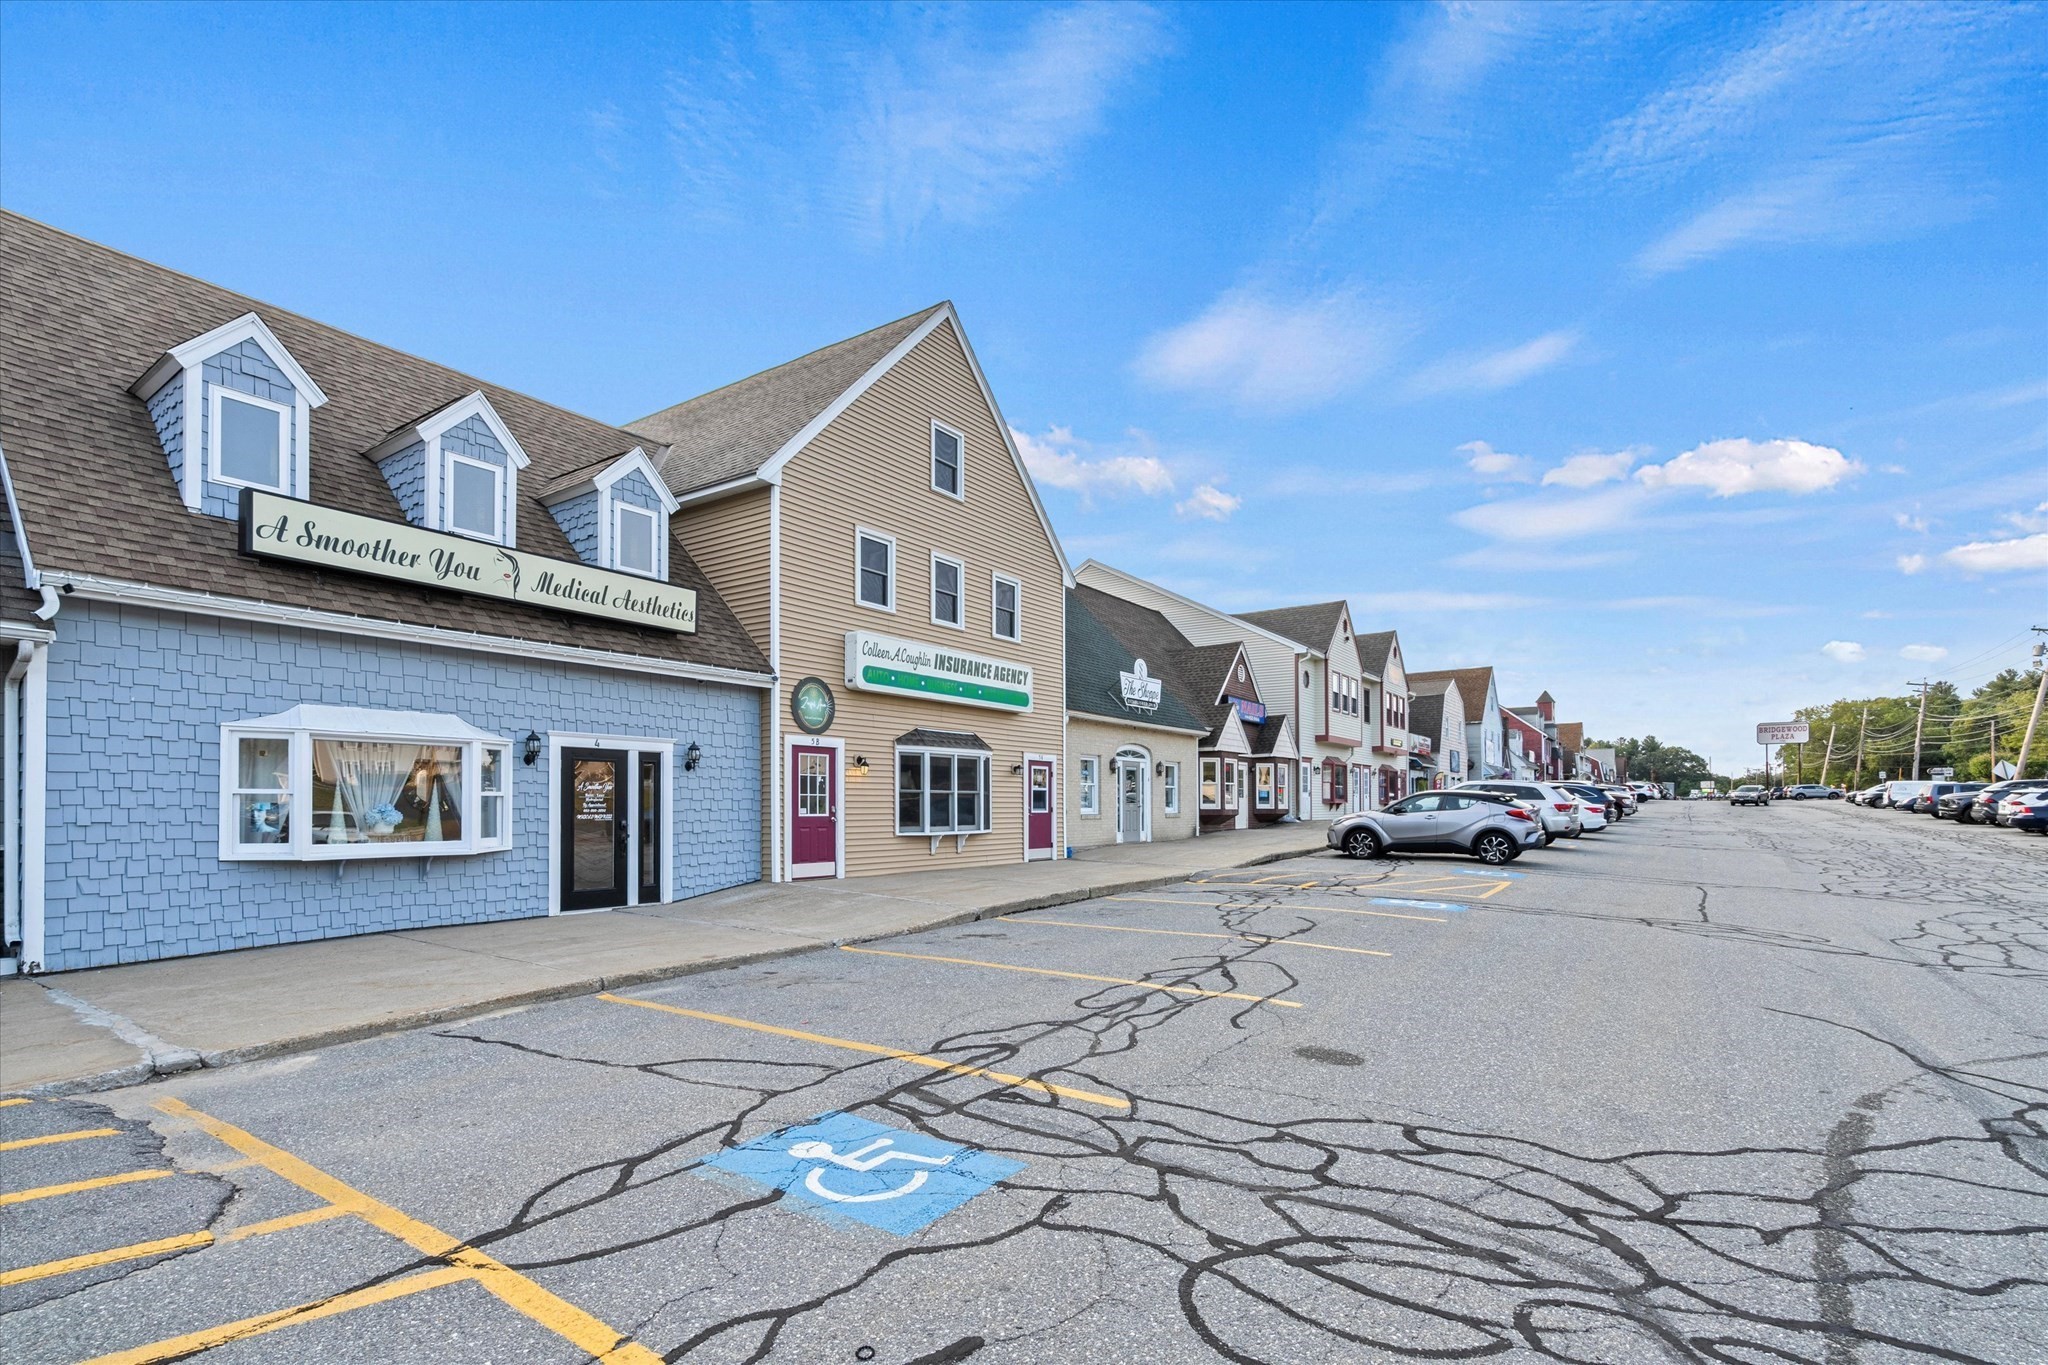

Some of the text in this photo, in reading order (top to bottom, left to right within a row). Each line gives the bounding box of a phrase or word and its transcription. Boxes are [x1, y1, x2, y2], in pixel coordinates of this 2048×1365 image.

[255, 514, 696, 623] A Smoother You Medical Aesthetics
[862, 640, 891, 661] Colleen
[901, 647, 931, 671] Coughlin
[934, 653, 993, 680] INSURANCE
[993, 665, 1029, 686] AGENCY
[866, 669, 890, 681] AUTO
[1123, 678, 1160, 702] The Shoppe
[1241, 699, 1265, 718] NAILS
[1758, 725, 1808, 734] BRIDGEWOOD
[595, 738, 600, 747] 4
